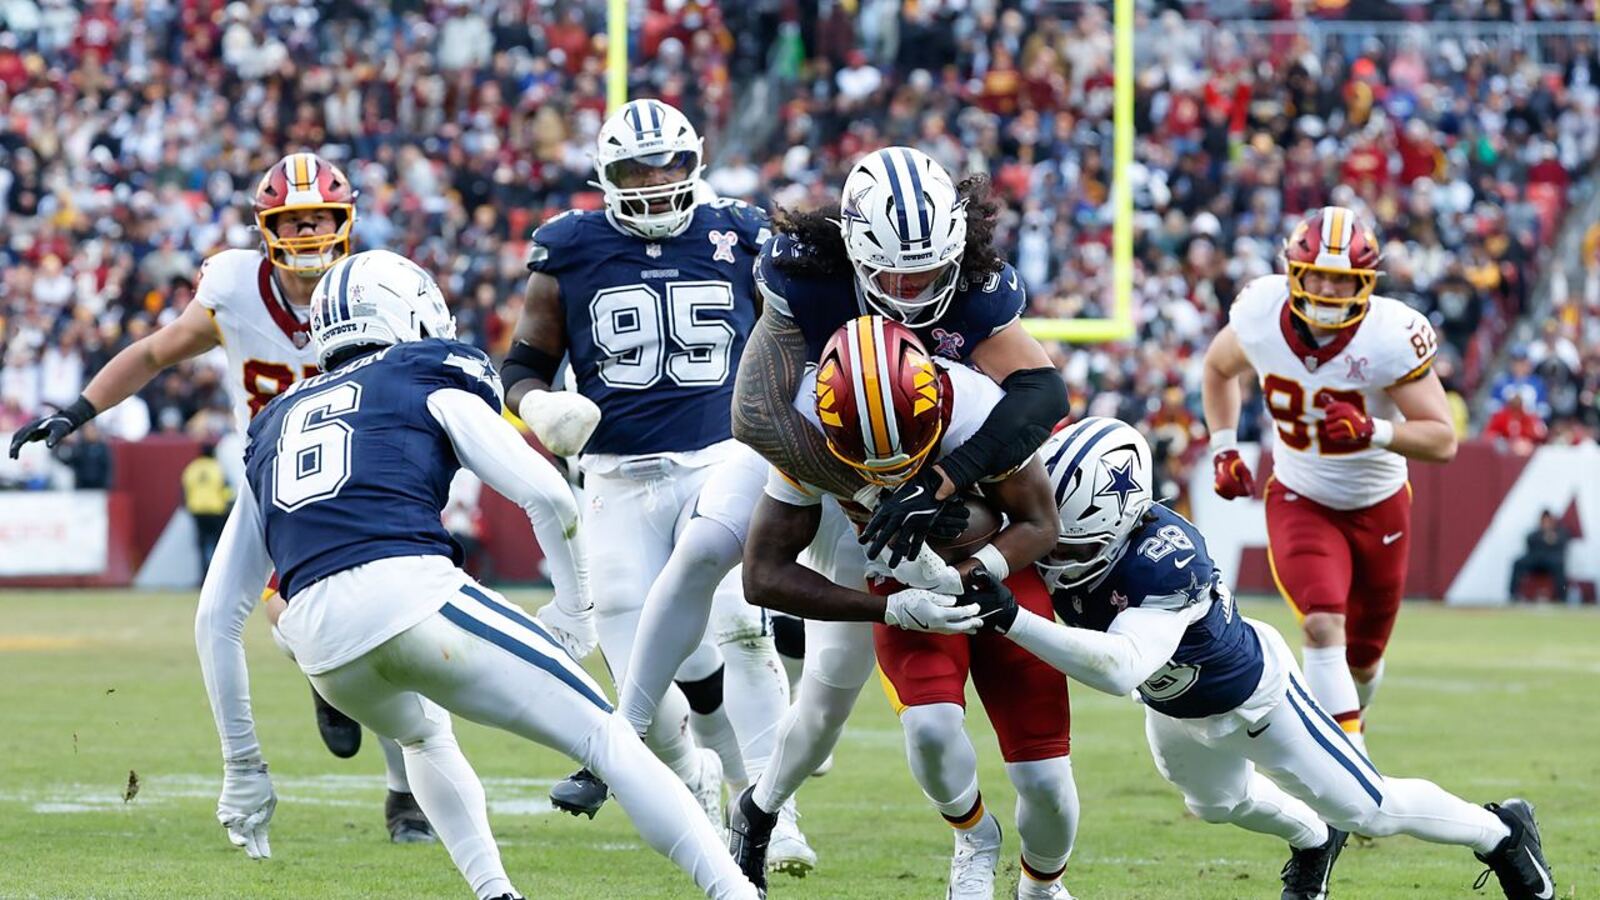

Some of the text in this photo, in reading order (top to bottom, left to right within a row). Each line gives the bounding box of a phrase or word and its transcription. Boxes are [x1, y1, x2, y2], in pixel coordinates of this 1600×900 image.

[588, 280, 736, 389] 95
[272, 381, 362, 513] 6
[1136, 524, 1196, 564] 28
